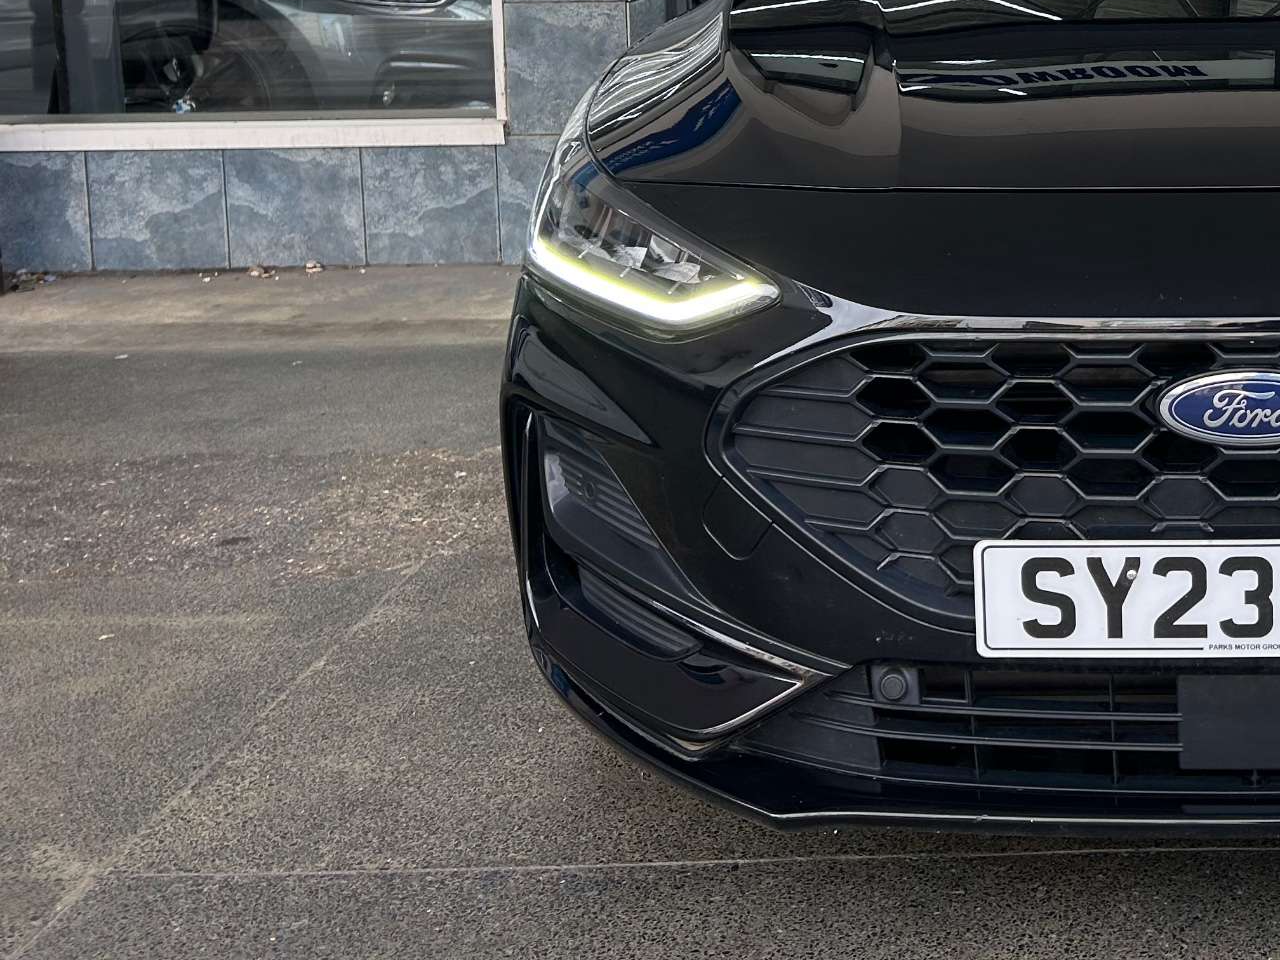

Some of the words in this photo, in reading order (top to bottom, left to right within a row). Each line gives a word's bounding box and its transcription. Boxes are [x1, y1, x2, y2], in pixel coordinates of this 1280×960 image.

[1022, 556, 1274, 639] SY23
[1208, 643, 1233, 651] PARKS
[1234, 643, 1261, 651] MOTOR
